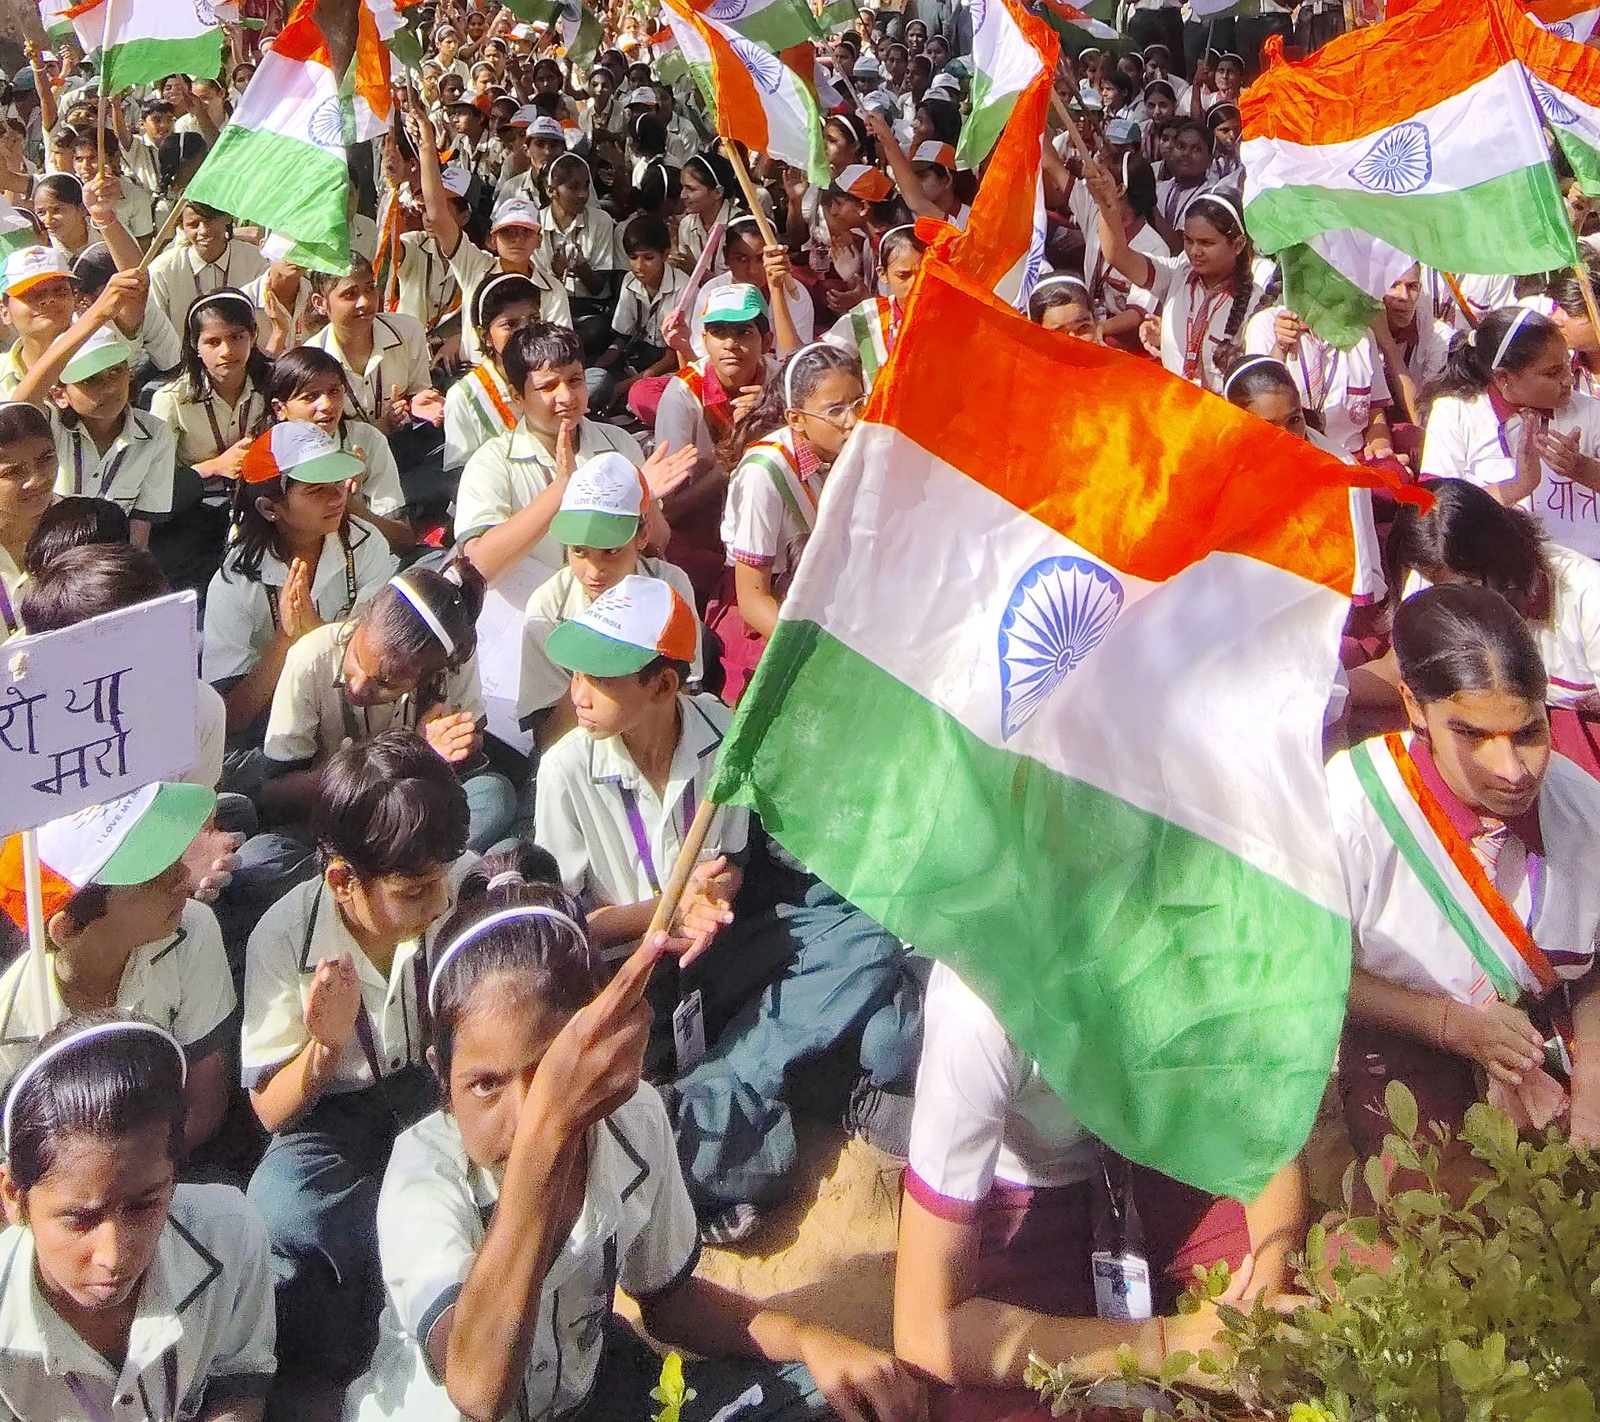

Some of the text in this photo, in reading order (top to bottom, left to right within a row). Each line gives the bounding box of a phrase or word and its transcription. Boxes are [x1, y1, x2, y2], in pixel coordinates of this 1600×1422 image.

[602, 616, 622, 631] INDIA
[101, 813, 122, 838] LOVE
[120, 798, 133, 813] MY
